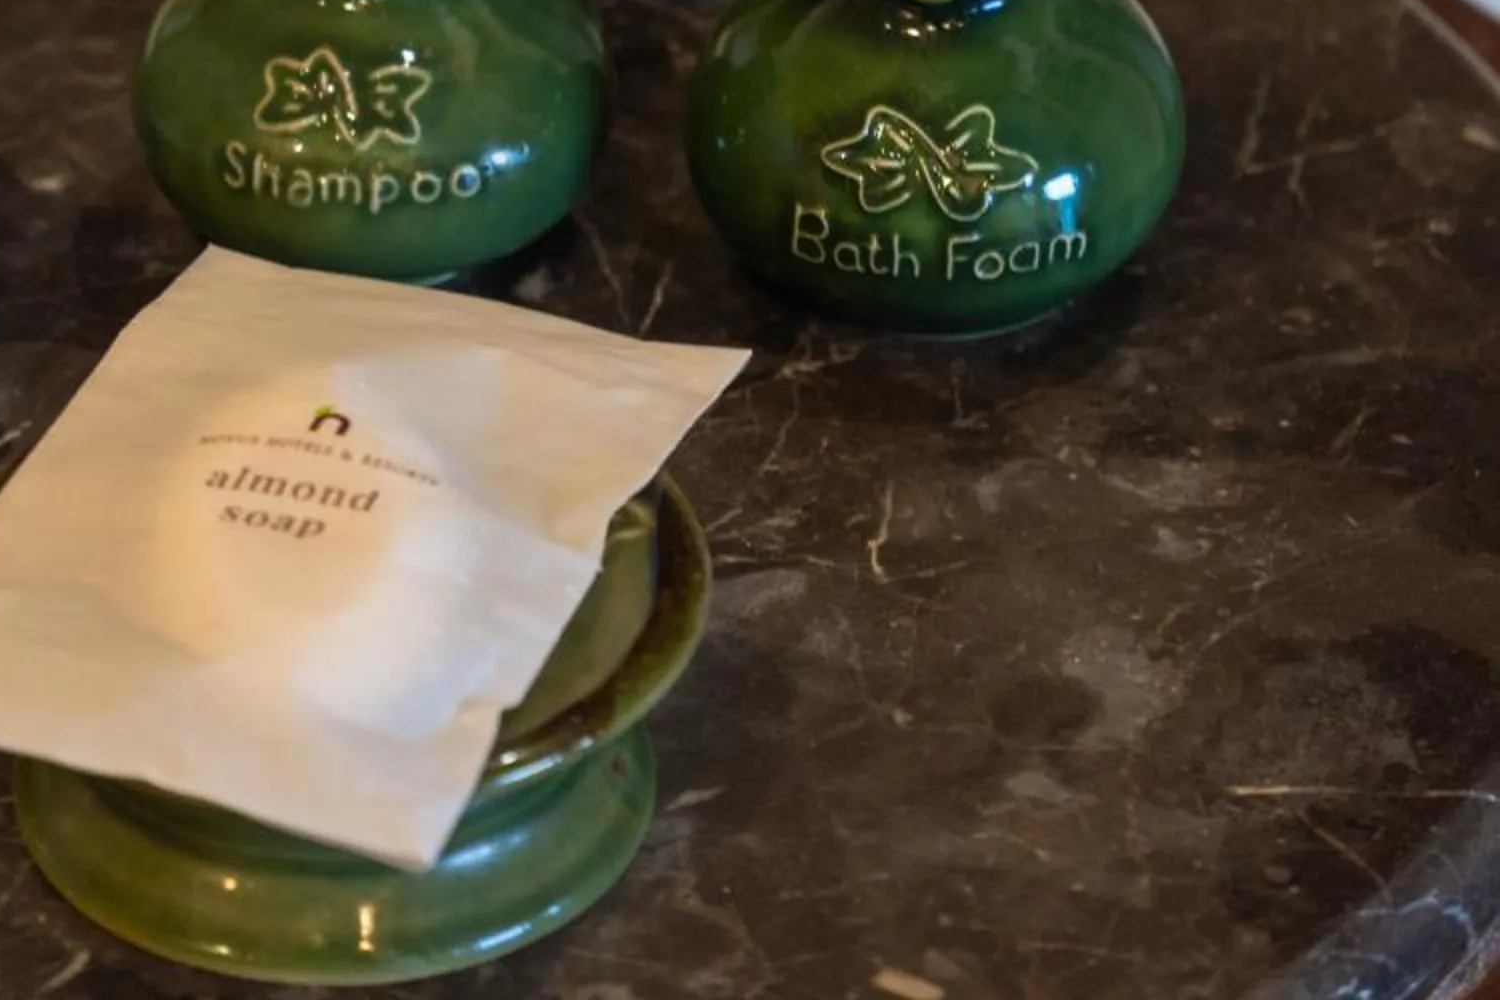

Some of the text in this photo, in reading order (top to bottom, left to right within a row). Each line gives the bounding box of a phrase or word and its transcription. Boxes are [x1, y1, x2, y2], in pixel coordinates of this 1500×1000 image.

[224, 141, 481, 214] Shampoo
[791, 202, 1088, 281] Bath Foam
[204, 466, 380, 513] almond
[217, 504, 327, 540] soap
